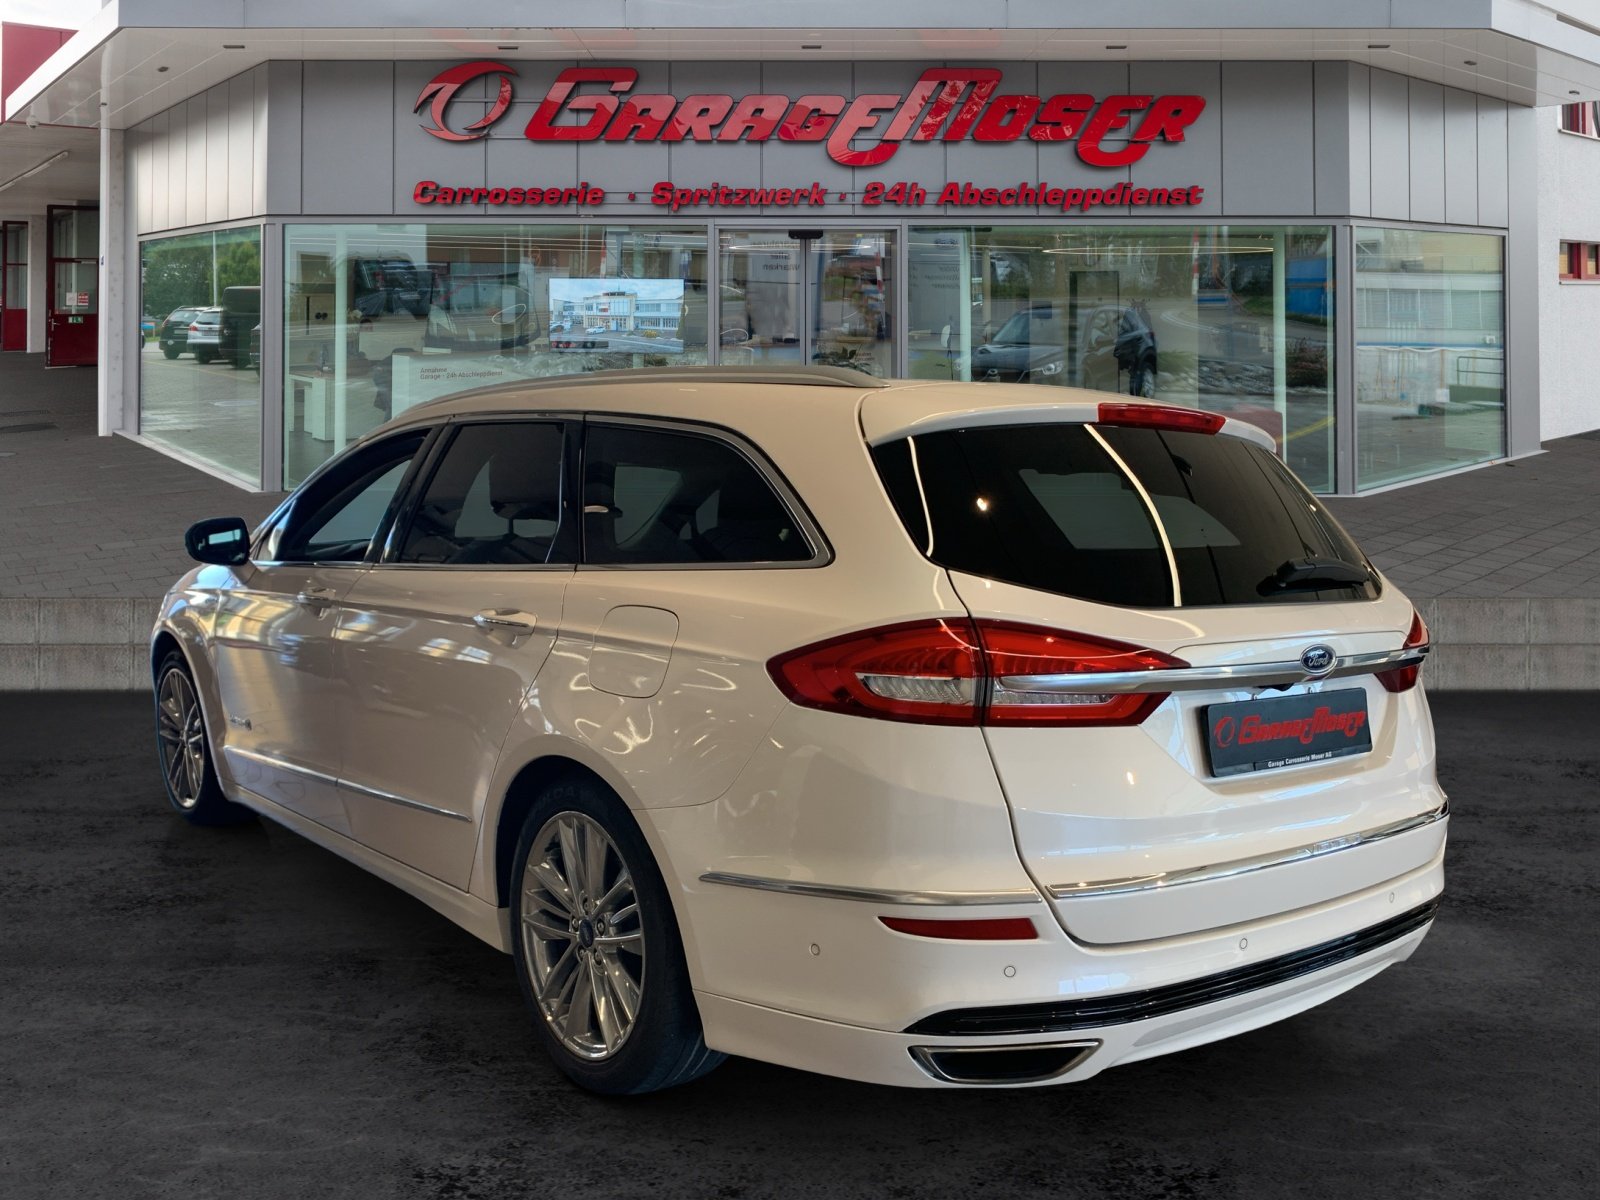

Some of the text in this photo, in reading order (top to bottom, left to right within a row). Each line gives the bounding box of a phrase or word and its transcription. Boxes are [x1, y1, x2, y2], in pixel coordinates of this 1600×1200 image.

[413, 181, 1204, 211] Carrosserie Spritzwerk 24h Abschleppdienst
[458, 370, 503, 378] Abschleppdienst
[1308, 649, 1329, 667] Ford
[1267, 759, 1285, 768] Garage
[1285, 755, 1310, 765] Carrosserie
[1311, 753, 1325, 761] Moser
